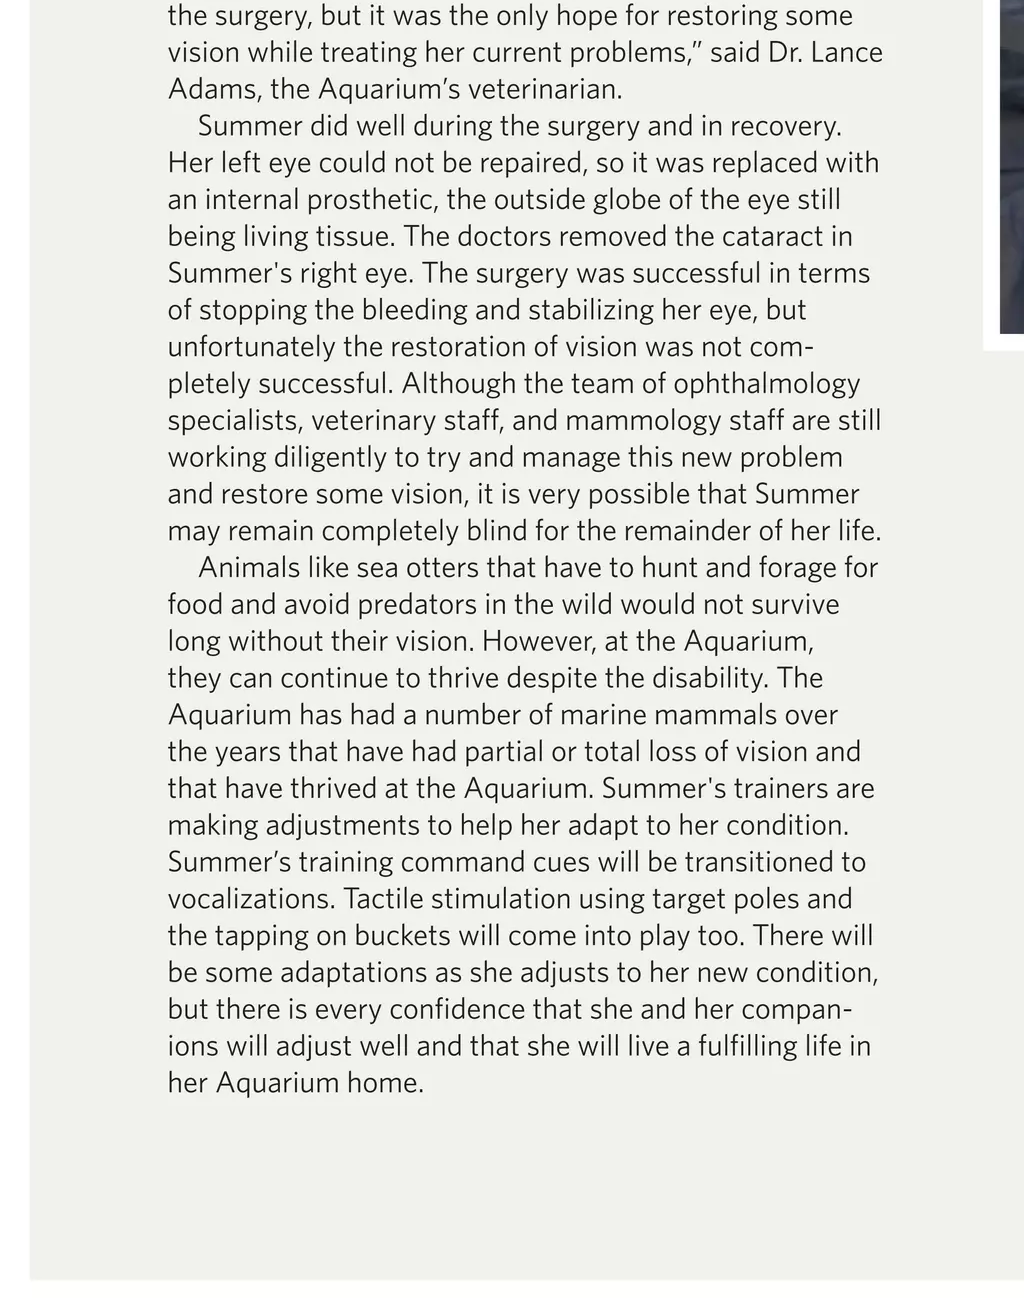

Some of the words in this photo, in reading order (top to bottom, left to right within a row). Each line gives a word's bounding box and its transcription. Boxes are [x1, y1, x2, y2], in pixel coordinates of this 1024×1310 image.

[168, 41, 238, 62] vision
[248, 40, 312, 62] while
[321, 41, 417, 67] treating
[426, 40, 465, 62] her
[473, 42, 561, 62] current
[571, 40, 702, 67] problems,”
[711, 40, 759, 62] said
[770, 41, 802, 62] Dr.
[813, 41, 882, 62] Lance
[169, 334, 335, 362] unfortunately
[344, 334, 382, 357] the
[392, 335, 525, 357] restoration
[535, 334, 558, 357] of
[566, 335, 636, 357] vision
[646, 341, 693, 357] was
[703, 337, 741, 357] not
[750, 341, 813, 357] com-
[170, 629, 220, 656] long
[229, 629, 323, 651] without
[331, 629, 388, 651] their
[396, 630, 473, 651] vision.
[484, 630, 596, 655] However,
[605, 631, 628, 651] at
[636, 629, 675, 651] the
[684, 629, 813, 656] Aquarium,
[168, 886, 334, 909] vocalizations.
[343, 886, 423, 909] Tactile
[432, 886, 570, 909] stimulation
[580, 887, 645, 913] using
[653, 889, 725, 913] target
[735, 886, 799, 913] poles
[808, 886, 851, 909] and
[169, 1070, 208, 1093] her
[216, 1071, 338, 1097] Aquarium
[349, 1070, 423, 1093] home.
